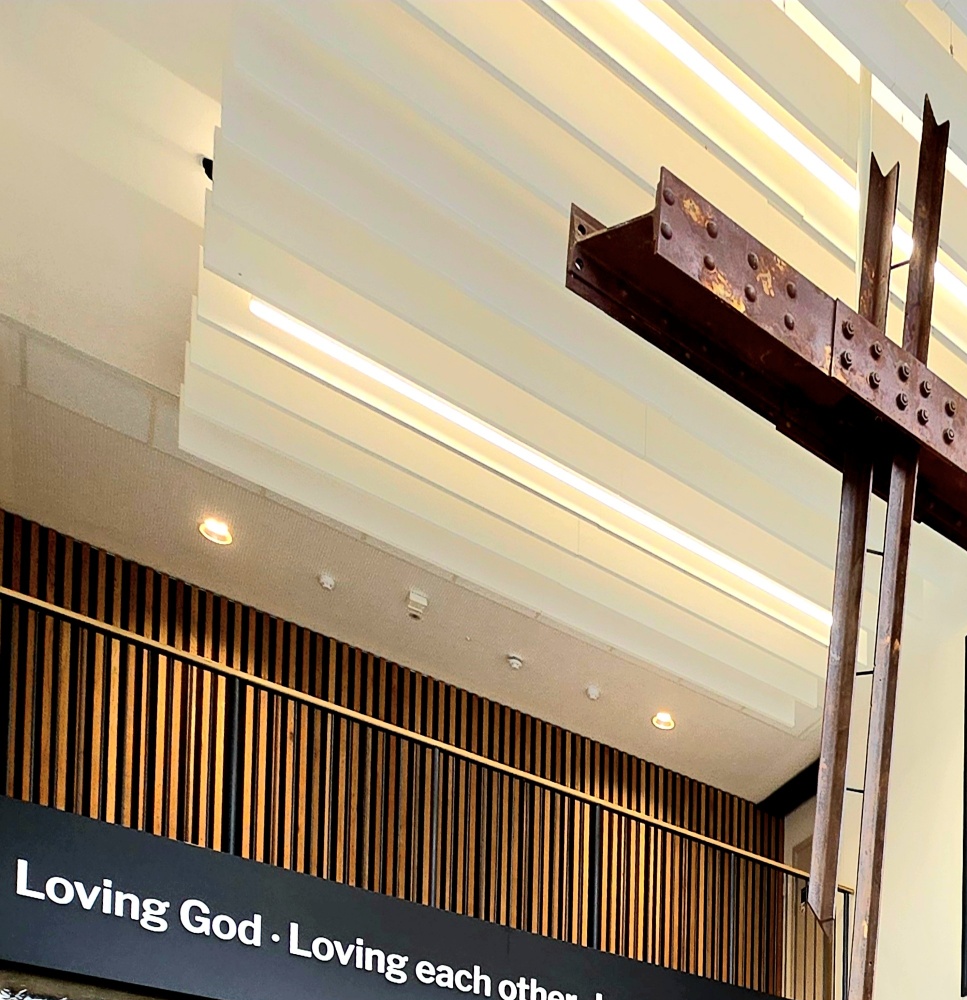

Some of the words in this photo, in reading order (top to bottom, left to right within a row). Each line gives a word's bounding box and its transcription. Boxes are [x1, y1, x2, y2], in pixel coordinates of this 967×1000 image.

[16, 858, 170, 932] Loving
[179, 899, 262, 947] God
[289, 922, 409, 984] Loving
[415, 960, 492, 997] each
